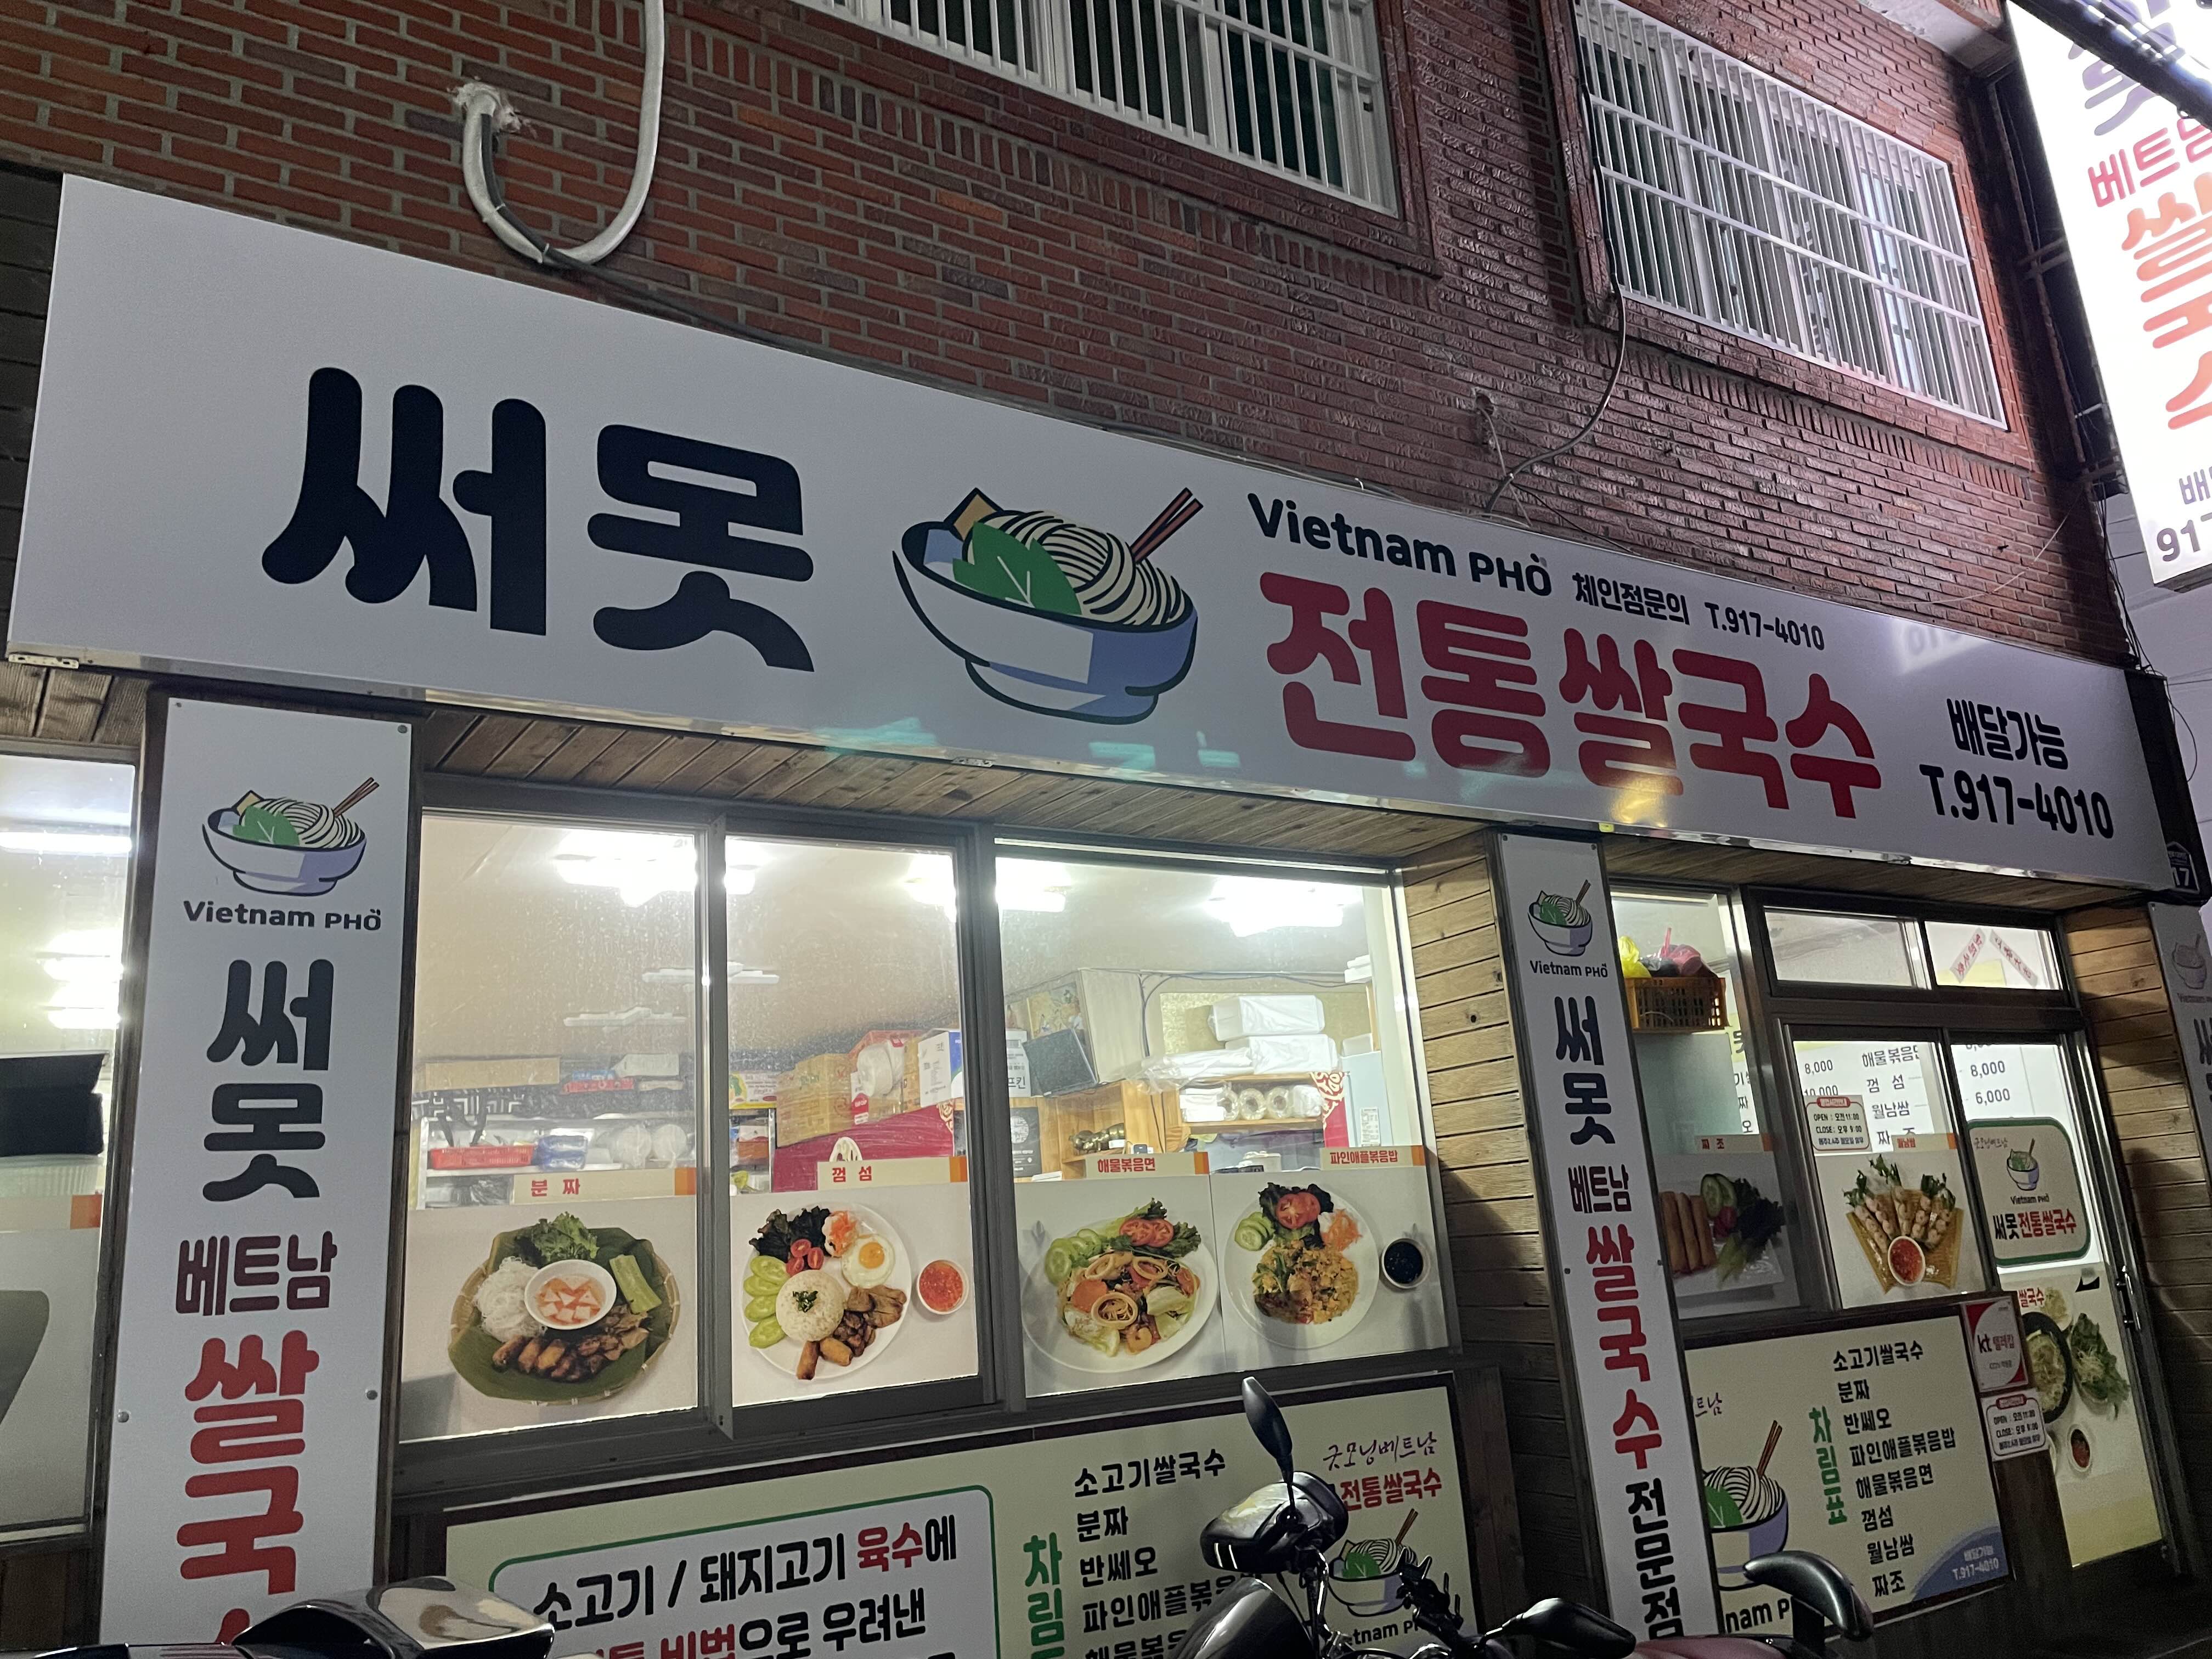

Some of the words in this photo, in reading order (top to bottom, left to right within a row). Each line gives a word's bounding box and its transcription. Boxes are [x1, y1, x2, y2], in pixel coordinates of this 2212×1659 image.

[261, 366, 815, 673] 써못
[1247, 492, 1456, 577] Vietnam
[1572, 572, 1690, 625] 체인점문의
[1703, 601, 1825, 651] T.917-4010
[1259, 571, 1882, 819] 전통쌀국수
[1946, 698, 2068, 770] 배달가능
[1919, 764, 2114, 839] T.917-4010
[183, 900, 315, 927] Vietnam
[1529, 960, 1582, 976] Vietnam
[203, 958, 335, 1202] 써못
[1554, 995, 1616, 1146] 써못
[1804, 1059, 1833, 1076] 8,000
[1970, 1060, 2006, 1079] 8,000
[1976, 1088, 2011, 1106] 6,000
[1330, 1149, 1398, 1165] 파인애플볶음밥
[1567, 1163, 1633, 1215] 베트남
[175, 1230, 338, 1316] 베트남
[1585, 1223, 1663, 1470] 쌀국수
[1832, 1340, 1924, 1372] 소고기쌀국수
[1977, 1333, 1993, 1354] kt
[1837, 1378, 1871, 1404] 분짜
[1074, 1448, 1226, 1498] 소고기쌀국수
[1323, 1431, 1437, 1471] 굿모닝베트남
[1808, 1405, 1848, 1525] 차림표
[1849, 1426, 1956, 1467] 파인애플볶음밥
[176, 1330, 320, 1645] 쌀국
[1340, 1466, 1442, 1512] 전통쌀국수
[1076, 1506, 1129, 1543] 분짜
[1861, 1505, 1894, 1532] 껌섬
[533, 1564, 654, 1632] 소고기
[699, 1532, 846, 1605] 돼지고기
[856, 1514, 957, 1573] 육수에
[1625, 1477, 1684, 1641] 전문점
[1871, 1570, 1906, 1598] 짜조
[822, 1587, 927, 1652] 우려낸
[1023, 1532, 1065, 1659] 차림
[1082, 1575, 1241, 1633] 파인애플볶
